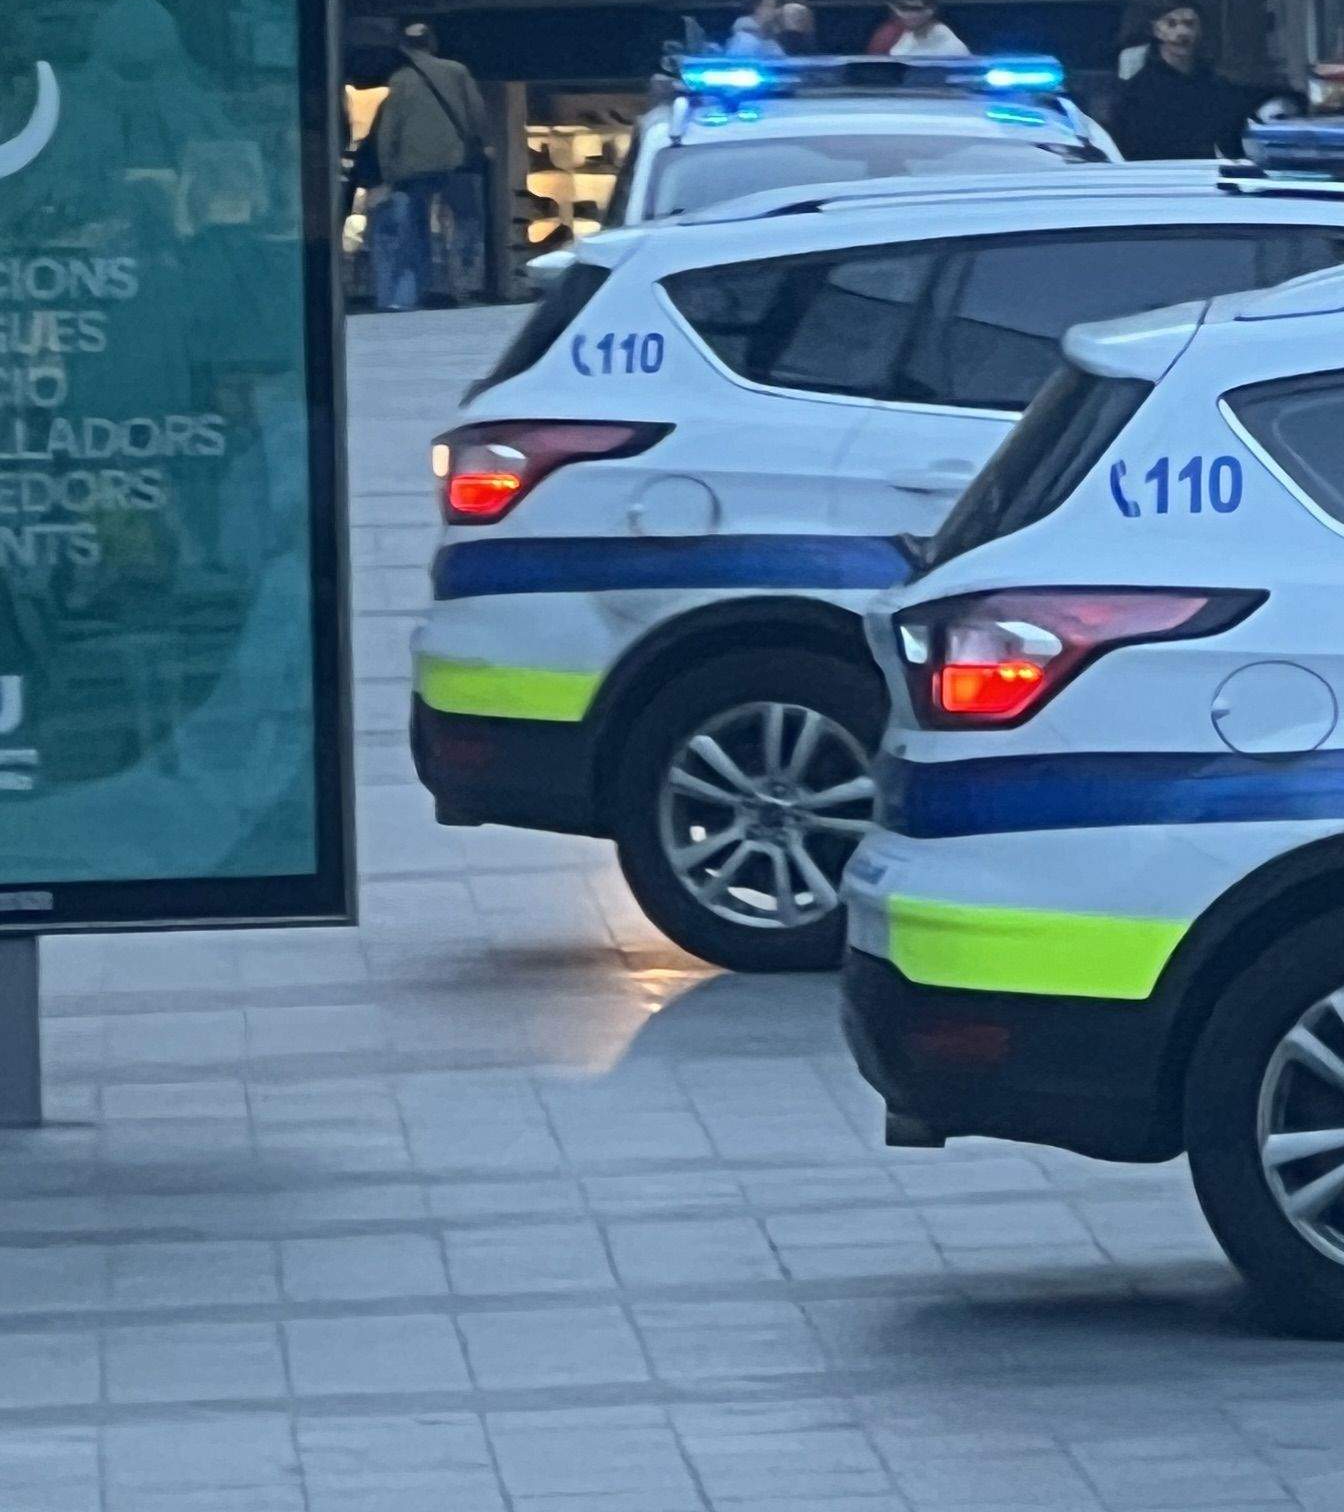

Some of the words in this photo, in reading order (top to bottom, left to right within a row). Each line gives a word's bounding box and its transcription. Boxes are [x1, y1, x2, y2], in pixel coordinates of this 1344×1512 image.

[0, 310, 107, 354] UES
[596, 333, 665, 374] 110
[1145, 455, 1243, 514] 110
